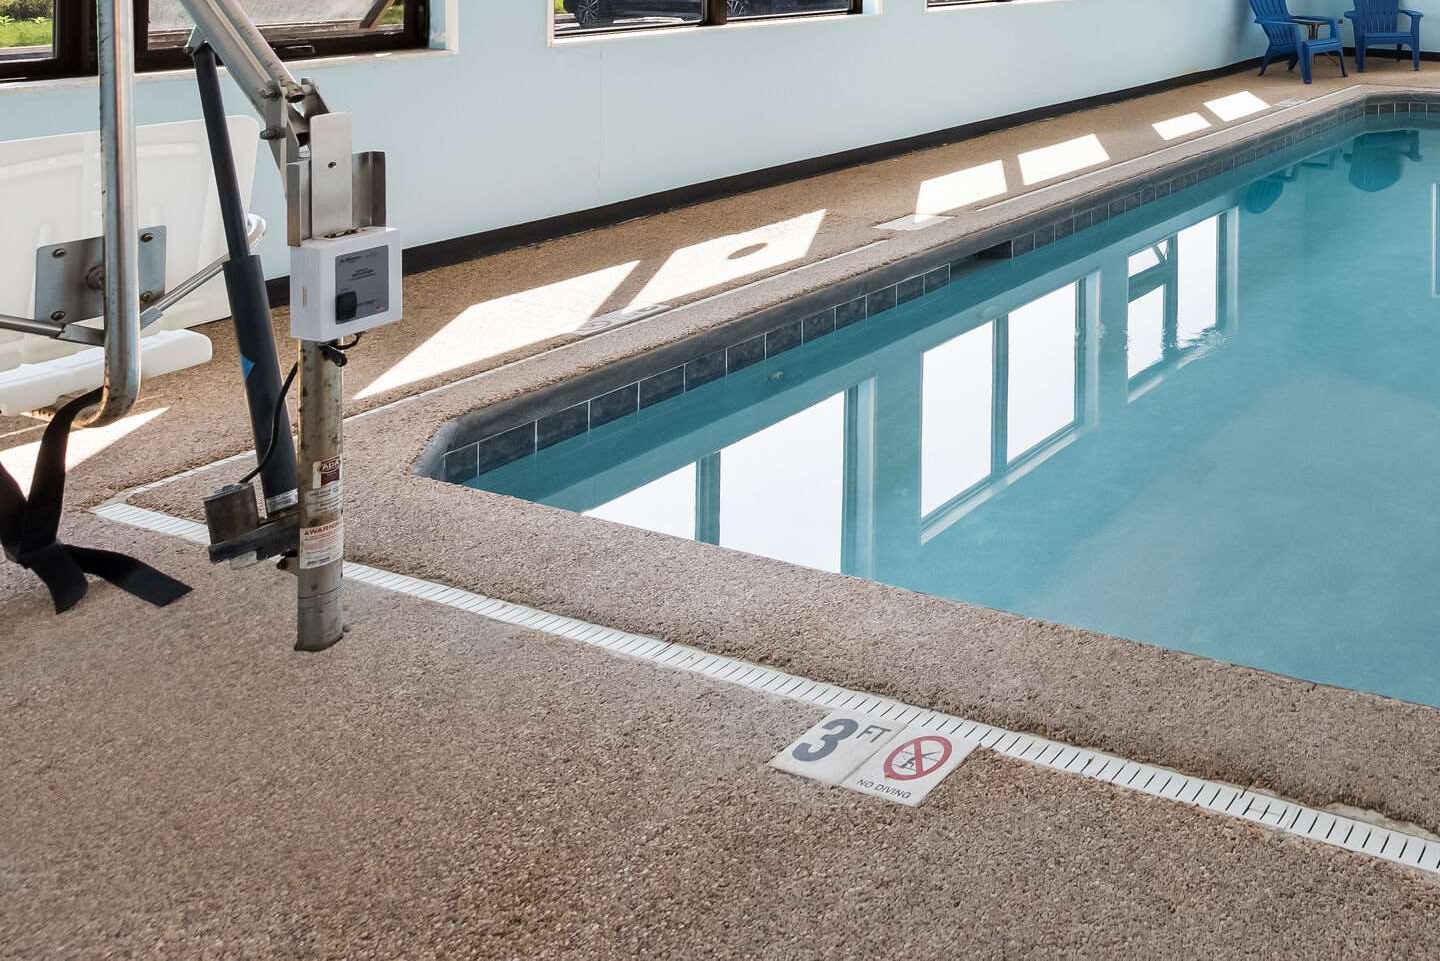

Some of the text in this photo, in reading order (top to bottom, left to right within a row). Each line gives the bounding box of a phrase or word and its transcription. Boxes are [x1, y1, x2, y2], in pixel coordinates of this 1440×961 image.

[792, 718, 892, 762] 3 FT
[856, 779, 912, 799] NO DIVING
